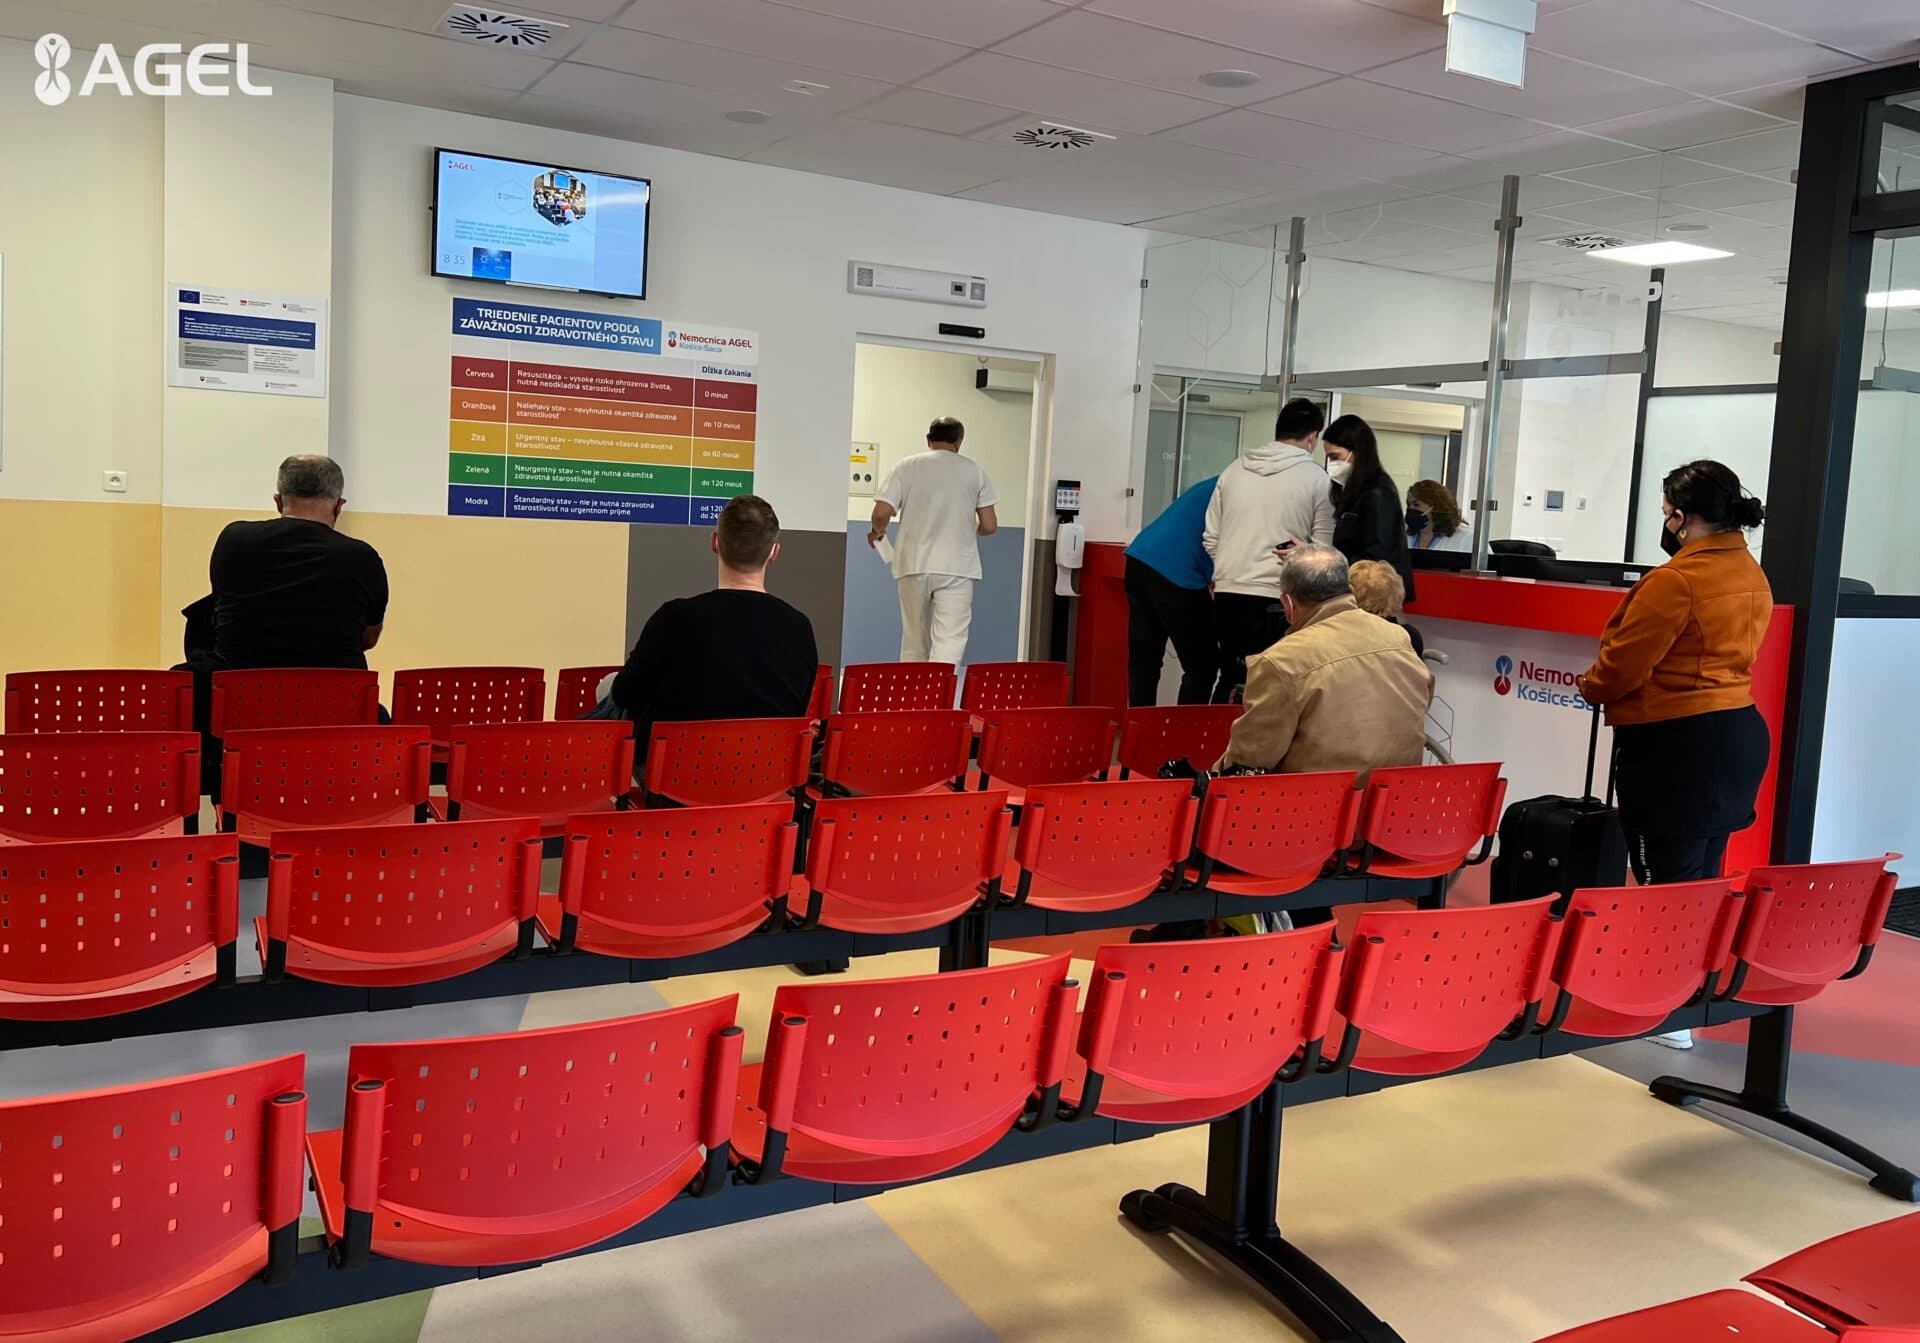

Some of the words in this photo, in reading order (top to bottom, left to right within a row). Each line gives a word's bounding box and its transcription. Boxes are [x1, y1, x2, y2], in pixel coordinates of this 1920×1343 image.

[453, 162, 474, 171] AGEL
[477, 307, 538, 323] TRIEDENIE
[540, 314, 602, 330] PACIENTOV
[604, 320, 641, 335] PODĽA
[460, 317, 533, 335] ZÁVAŽNOSTI
[535, 326, 619, 344] ZDRAVOTNÉHO
[620, 335, 654, 348] STAVU
[679, 333, 727, 345] Nemocnica
[728, 338, 753, 349] AGEL
[465, 368, 495, 379] Červená
[724, 369, 752, 377] čakania
[517, 369, 562, 381] Resuscitácia
[595, 377, 614, 385] riziko
[615, 379, 649, 389] ohrozenia
[517, 378, 538, 387] nutná
[540, 380, 580, 390] neodkladná
[710, 391, 729, 399] minút
[462, 400, 496, 411] Oranžová
[551, 404, 566, 412] stav
[574, 407, 613, 416] nevyhnutná
[712, 450, 721, 458] 60
[465, 465, 490, 474] Zelená
[514, 464, 557, 474] Neurgentný
[558, 466, 573, 474] stav
[593, 469, 600, 477] je
[622, 471, 653, 479] okamžitá
[514, 472, 550, 481] zdravotná
[465, 497, 488, 506] Modrá
[557, 498, 572, 506] stav
[591, 499, 598, 507] je
[600, 500, 620, 508] nutná
[621, 501, 655, 509] zdravotná
[570, 507, 609, 515] urgentnom
[1519, 660, 1584, 687] Nemoc
